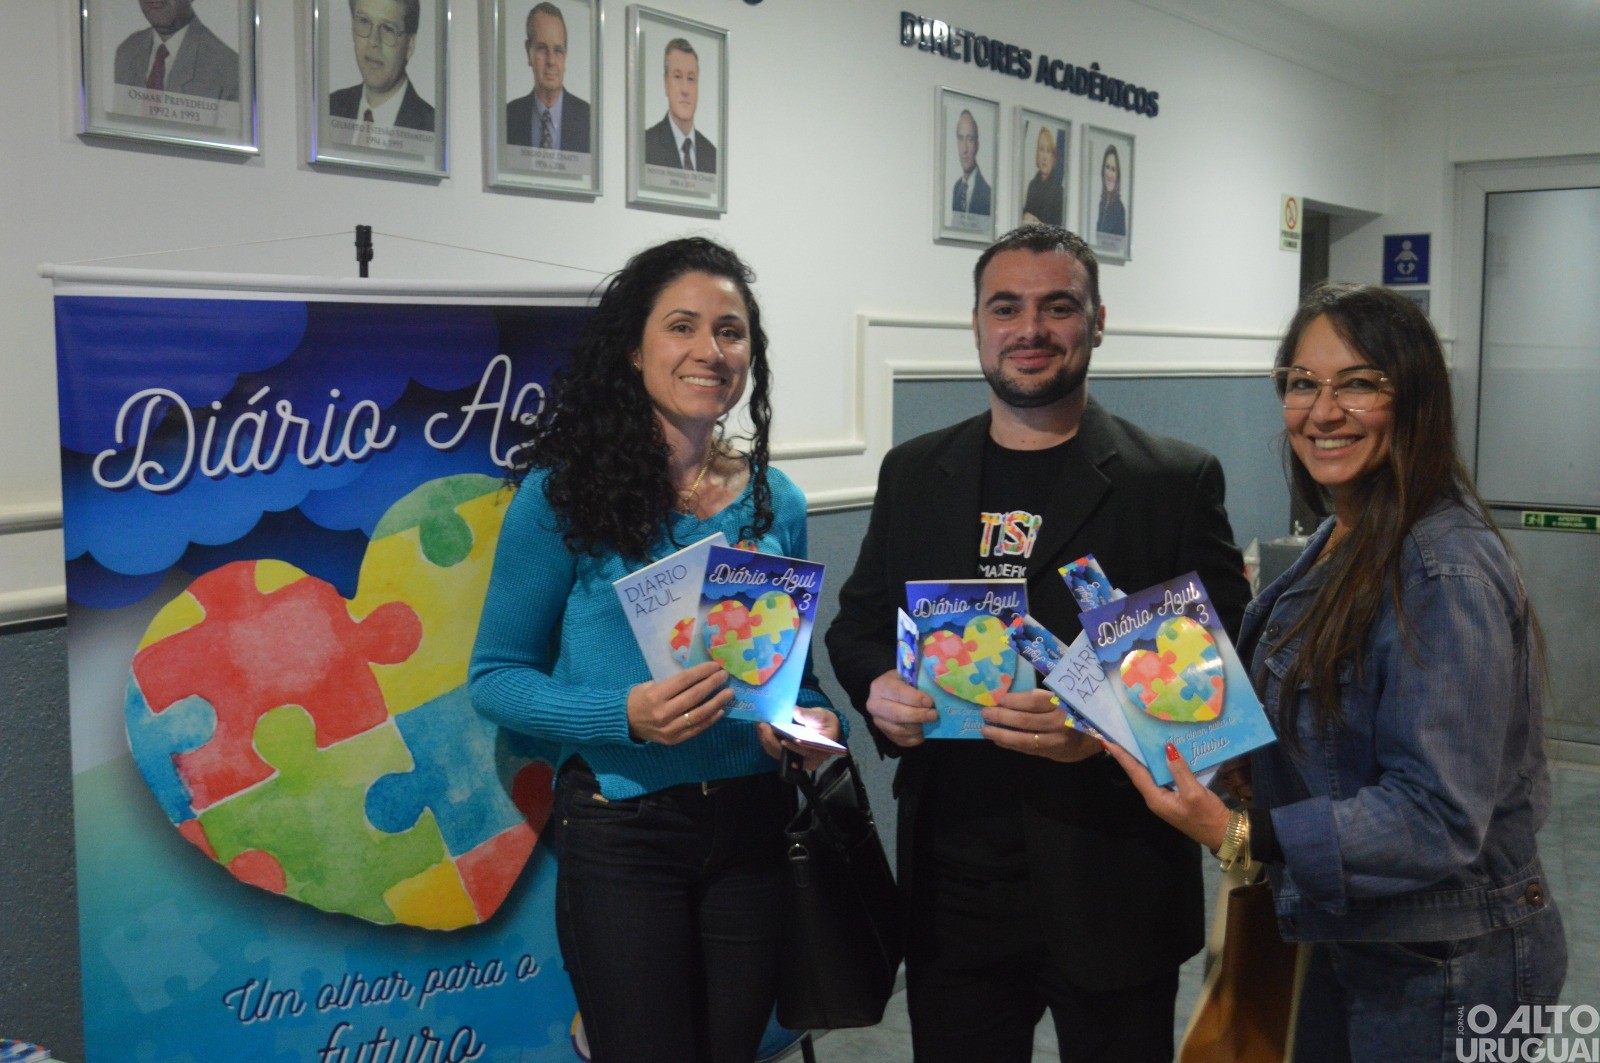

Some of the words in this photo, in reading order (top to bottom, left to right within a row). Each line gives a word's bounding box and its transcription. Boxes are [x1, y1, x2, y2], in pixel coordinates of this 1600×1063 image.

[900, 11, 1031, 79] DIRETORES
[1034, 55, 1159, 117] ACADÊMICOS
[149, 105, 170, 117] 1992
[180, 110, 200, 121] 1993
[93, 387, 396, 492] Diário
[624, 564, 688, 604] DIÁRIO
[709, 563, 768, 586] Diário
[772, 568, 815, 593] Azul
[634, 593, 682, 619] AZUL
[799, 593, 812, 611] 3
[912, 596, 970, 618] Diário
[975, 591, 1020, 614] Azul
[1097, 608, 1154, 647] Diário
[1157, 581, 1201, 617] Azul
[1196, 604, 1210, 625] 3
[1058, 644, 1097, 692] DIÁR
[1077, 662, 1106, 704] AZU
[1190, 736, 1229, 766] futuro
[223, 977, 307, 1025] Um
[316, 970, 416, 1012] olhar
[416, 955, 508, 1009] para
[515, 953, 541, 982] o
[317, 1021, 487, 1063] futuro
